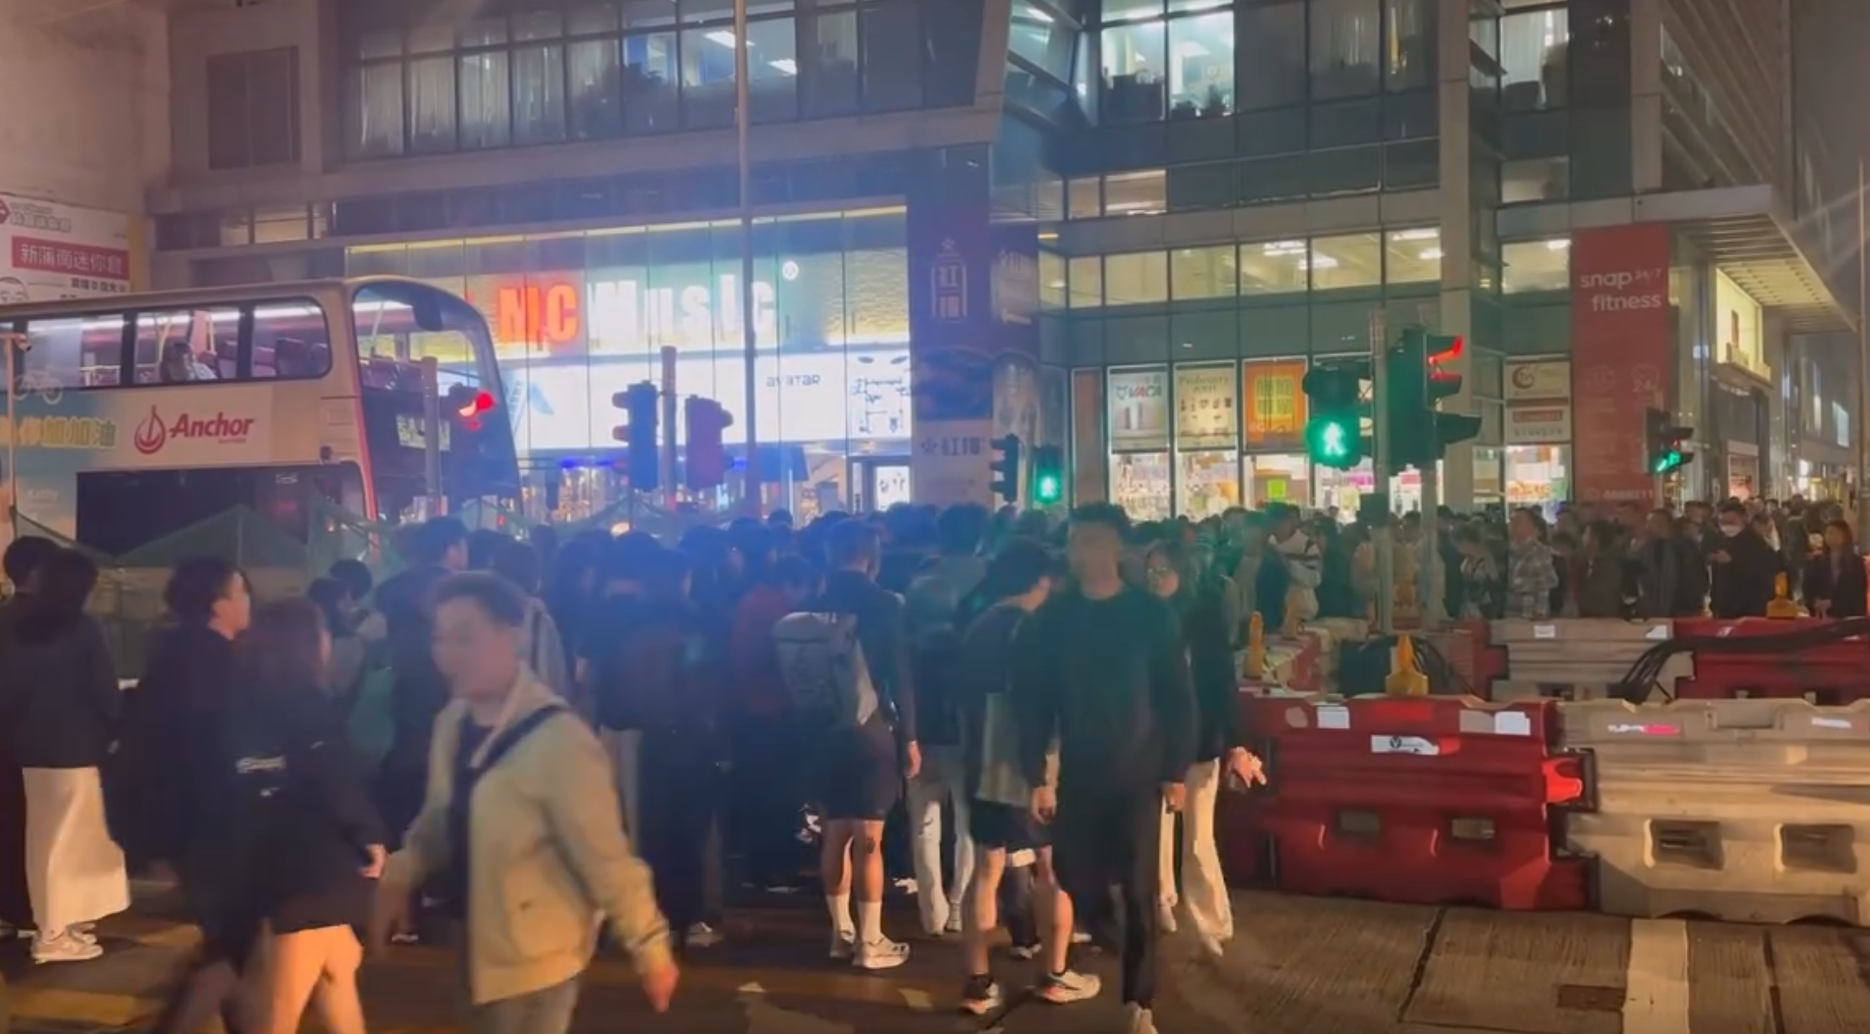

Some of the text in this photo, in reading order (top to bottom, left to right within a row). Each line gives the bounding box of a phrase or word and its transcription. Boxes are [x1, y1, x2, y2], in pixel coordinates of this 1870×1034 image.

[1580, 271, 1633, 291] snap
[587, 273, 775, 339] Music
[1591, 293, 1662, 312] fitness
[168, 411, 255, 439] Anchor
